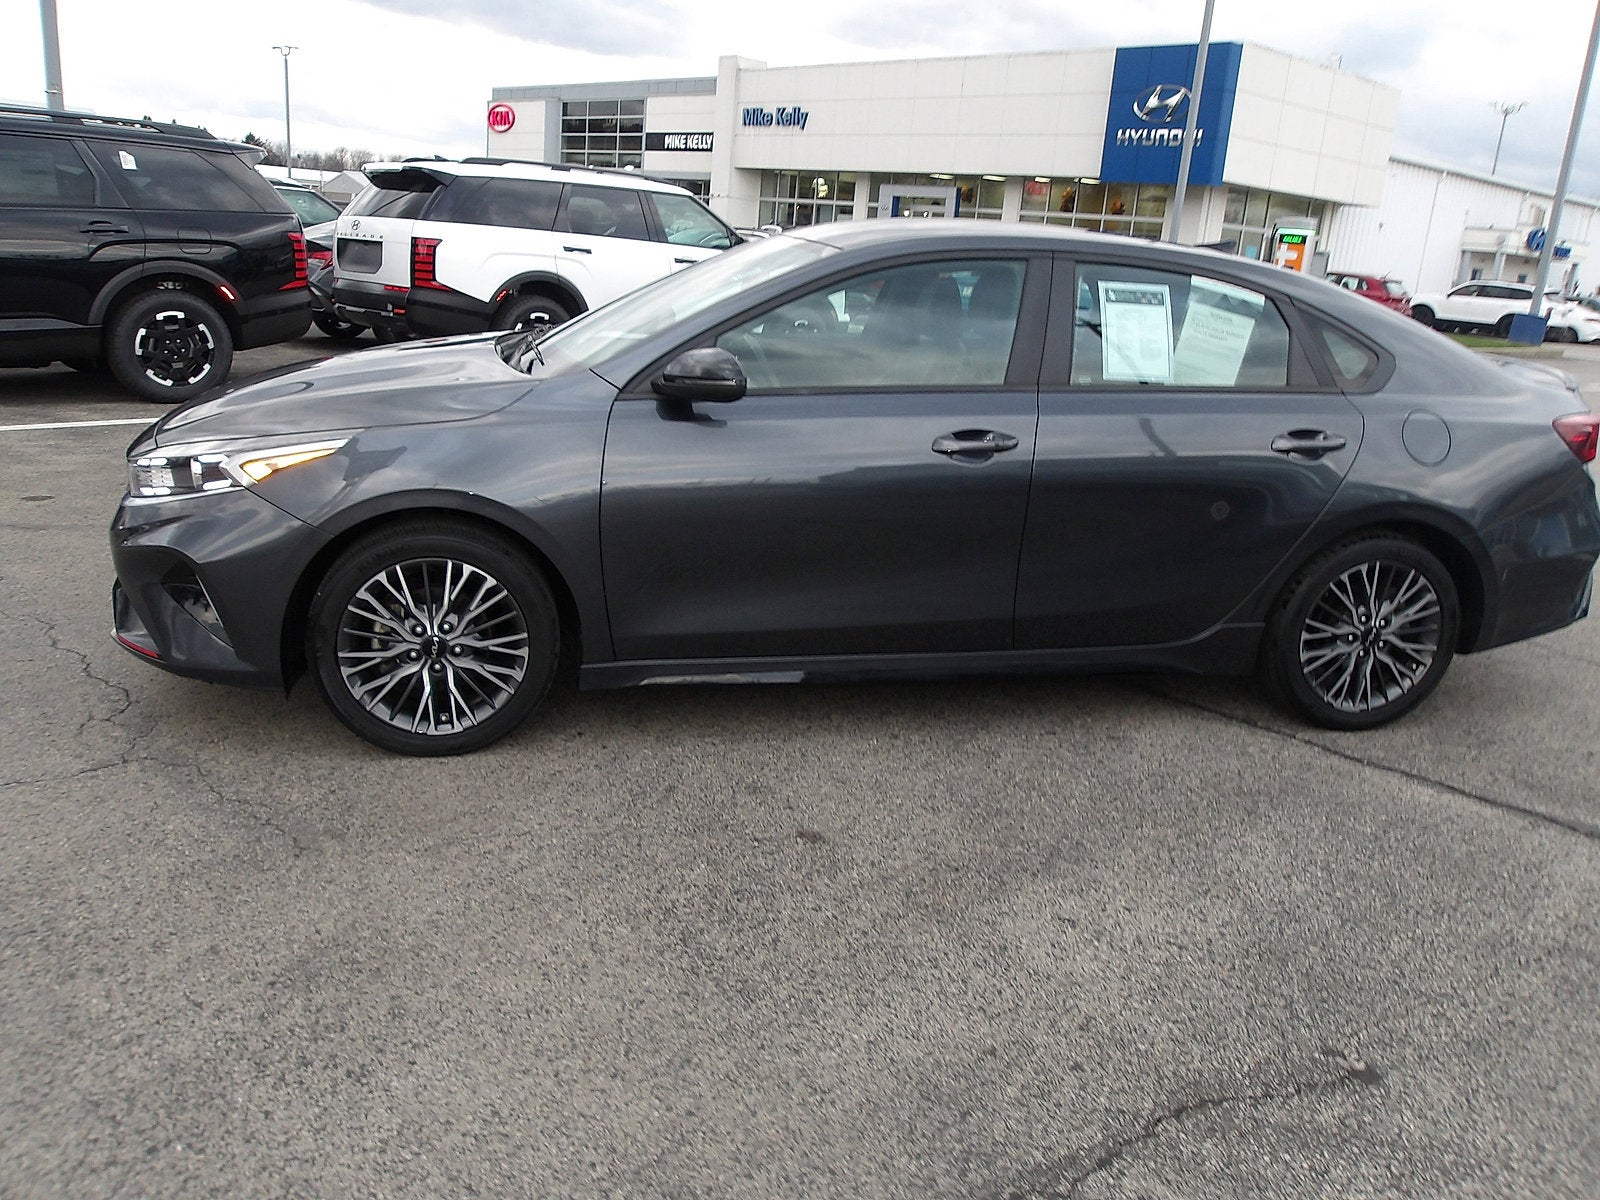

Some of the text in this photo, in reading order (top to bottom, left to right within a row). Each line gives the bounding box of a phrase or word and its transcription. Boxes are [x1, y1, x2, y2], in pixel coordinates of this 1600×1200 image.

[491, 110, 511, 126] KIA
[742, 106, 809, 131] Mike Kelly
[664, 134, 713, 149] MIKE KELLY
